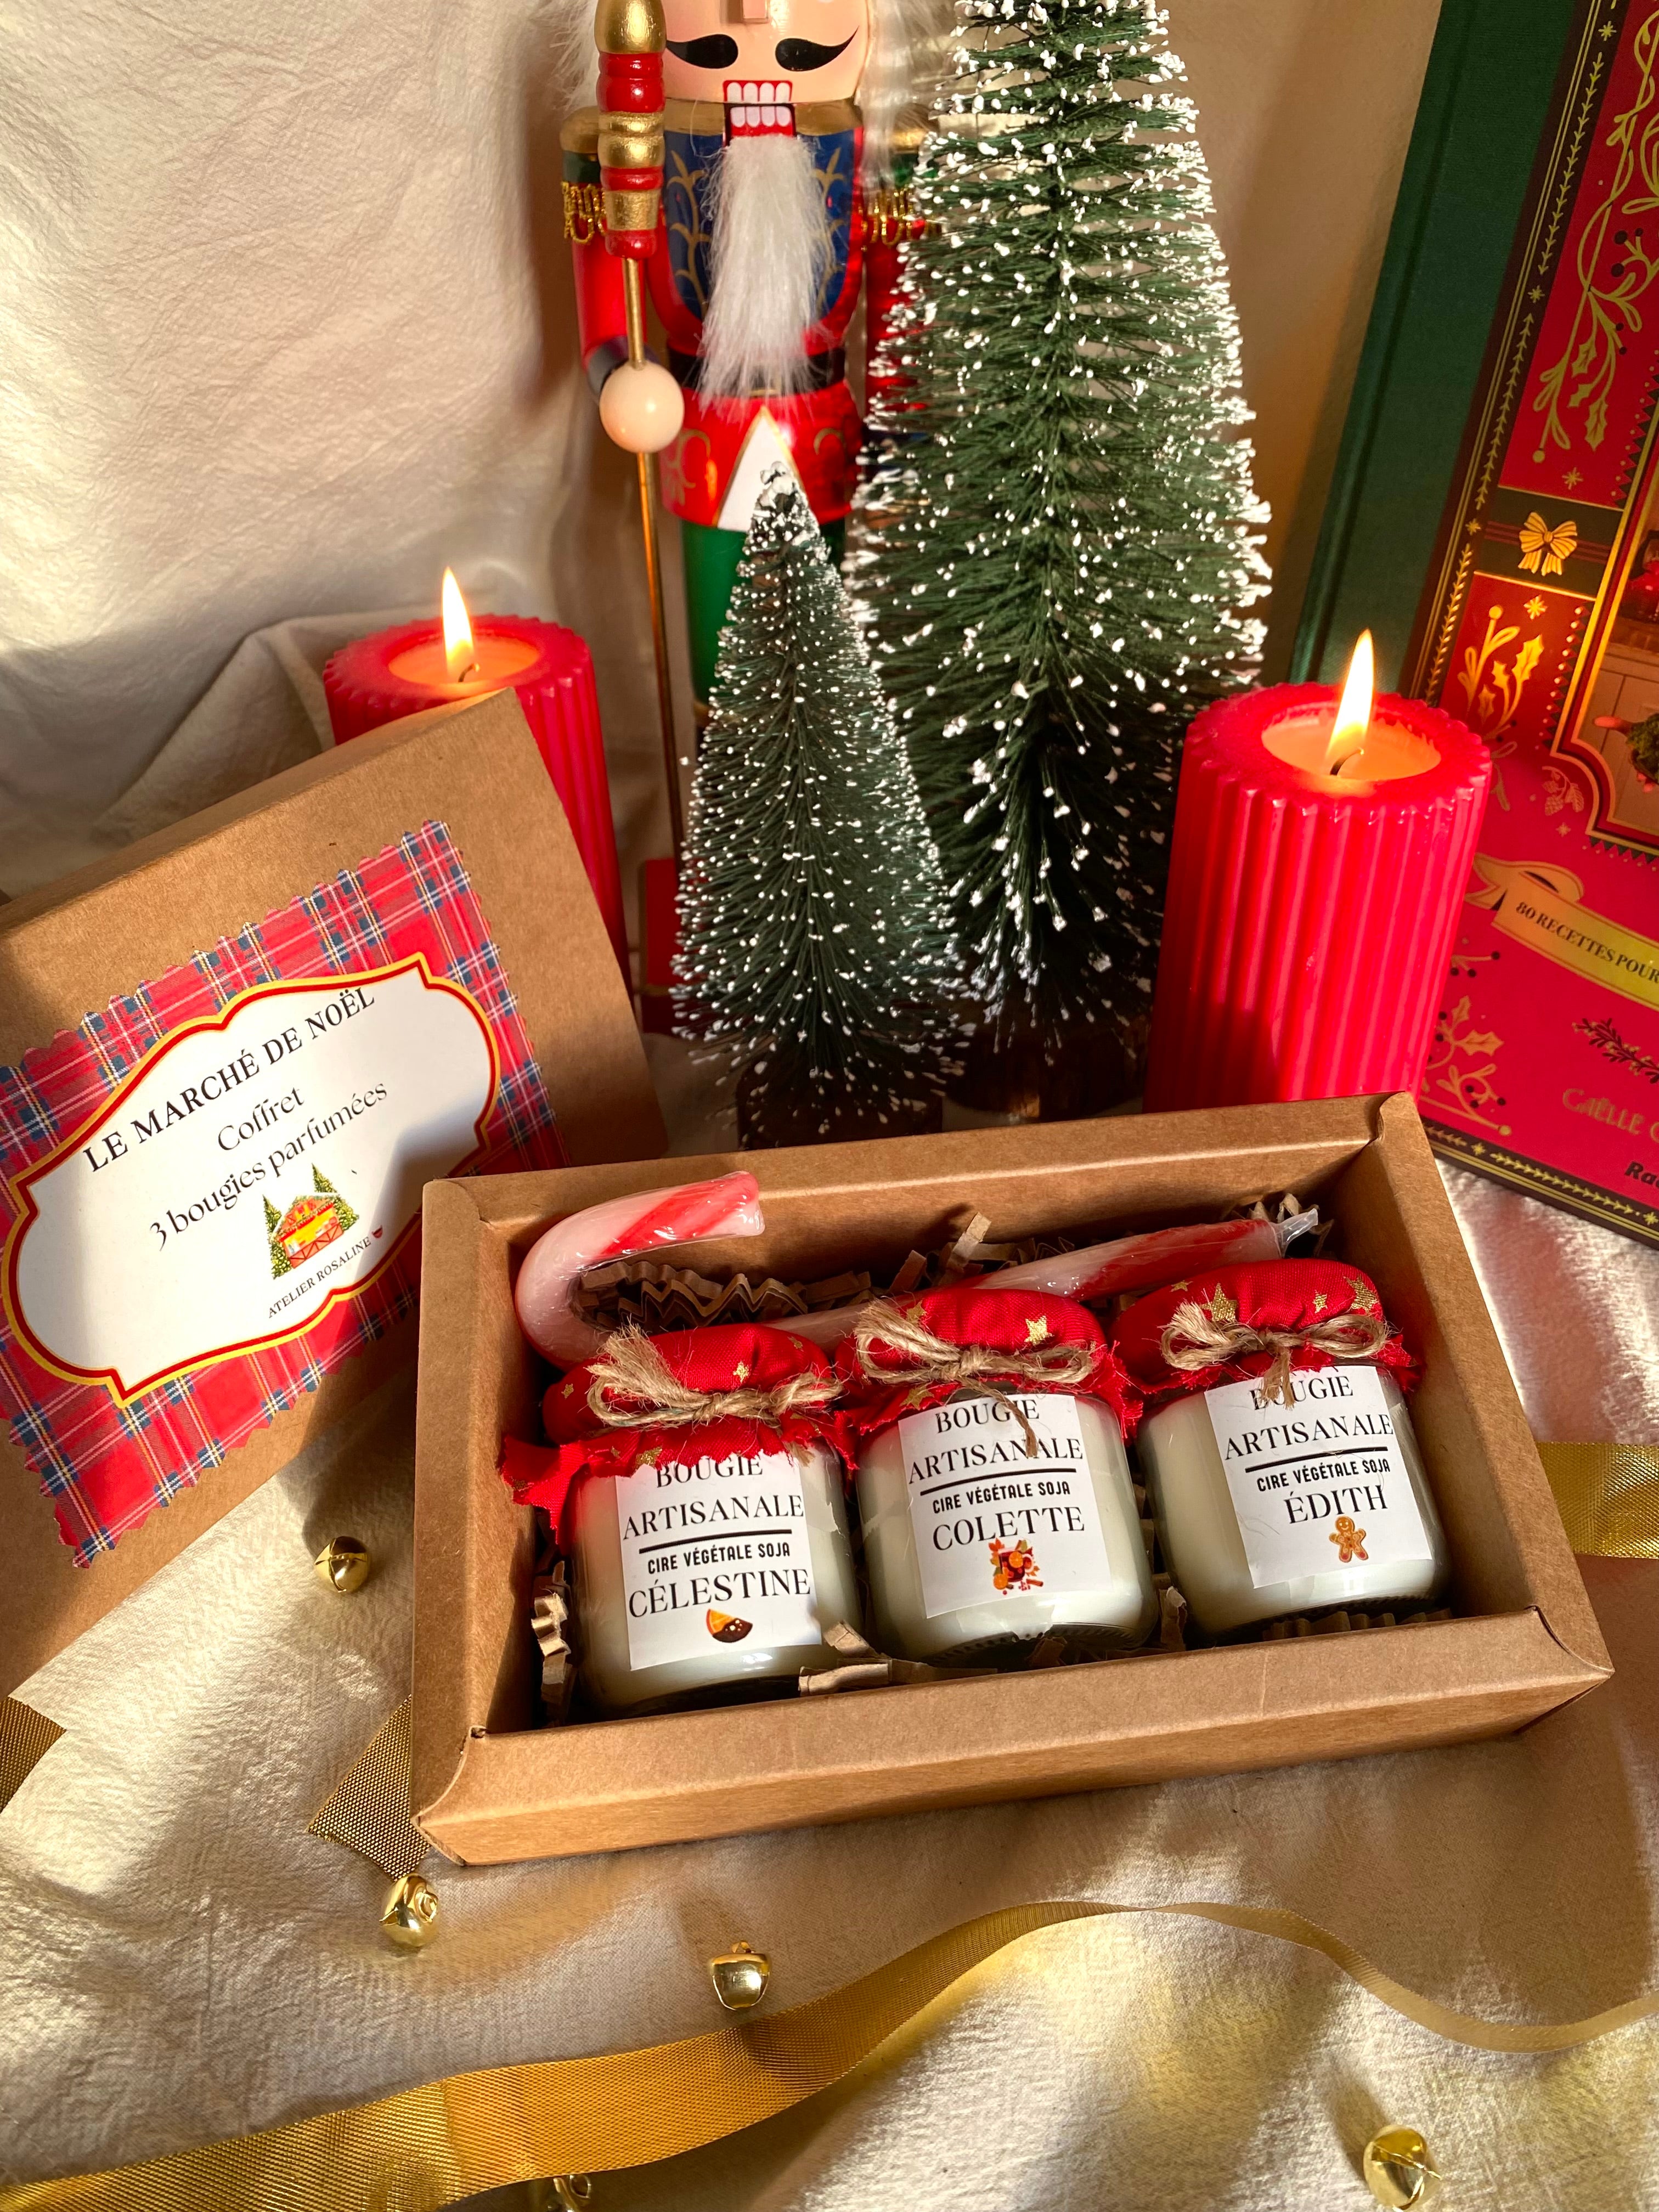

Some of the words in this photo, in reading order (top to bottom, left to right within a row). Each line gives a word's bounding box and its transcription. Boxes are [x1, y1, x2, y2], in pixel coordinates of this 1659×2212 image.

[1516, 902, 1536, 919] 80
[1536, 913, 1616, 962] RECETTES
[1615, 954, 1659, 984] POUR
[82, 1132, 128, 1172] LE
[130, 1049, 260, 1144] MARCHÉ
[262, 1028, 303, 1065] DE
[304, 987, 375, 1040] NOËL
[217, 1087, 305, 1151] Coffret
[149, 1221, 167, 1251] 3
[165, 1161, 266, 1234] bougies
[267, 1082, 387, 1177] parfumées
[269, 1278, 316, 1318] ATELIER
[316, 1236, 371, 1282] ROSALINE
[935, 1399, 1040, 1434] BOUGE
[1224, 1414, 1394, 1460] ARTISANALE
[932, 1497, 961, 1514] CIRE
[966, 1483, 1033, 1505] VÉGÉTALE
[1039, 1481, 1070, 1496] SOJA
[1256, 1473, 1289, 1492] CIRE
[1293, 1461, 1359, 1483] VÉGÉTALE
[1363, 1458, 1391, 1475] SOJA
[623, 1494, 804, 1540] ARTISANALE
[1283, 1485, 1389, 1524] ÉDITH
[933, 1506, 1085, 1551] COLETTE
[647, 1554, 678, 1575] CIRE
[684, 1544, 753, 1567] VÉGÉTALE
[758, 1542, 790, 1558] SOJA
[629, 1568, 811, 1618] CÉLESTINE
